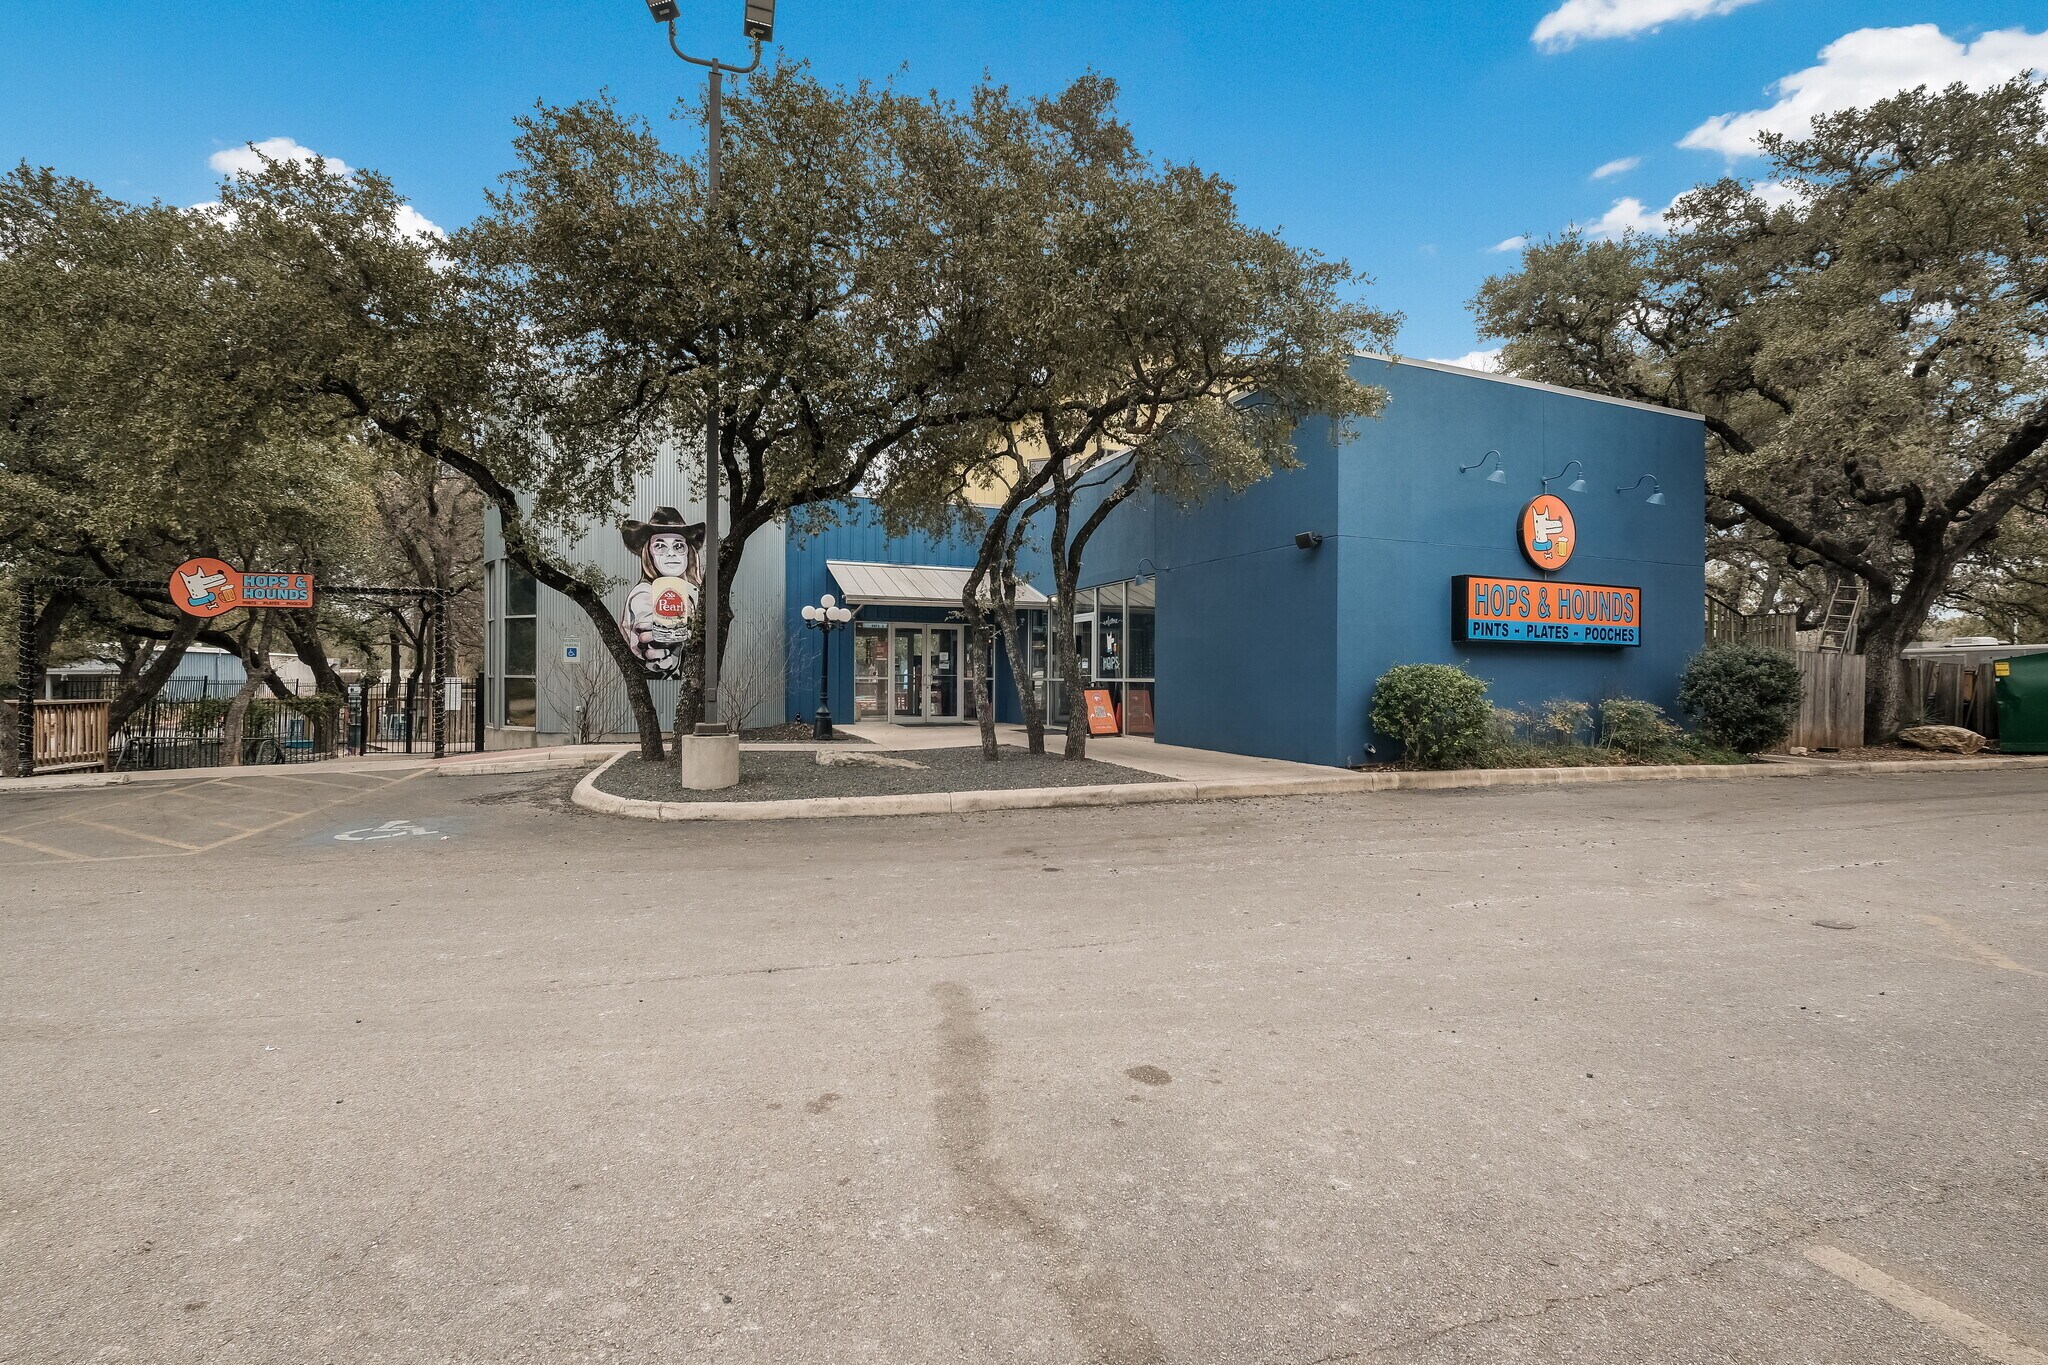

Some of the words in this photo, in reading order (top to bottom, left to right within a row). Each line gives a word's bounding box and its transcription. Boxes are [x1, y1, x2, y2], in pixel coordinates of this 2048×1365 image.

[243, 575, 289, 588] HOPS
[295, 576, 308, 588] &
[243, 588, 309, 601] HOUNDS
[1475, 583, 1530, 618] HOPS
[1538, 587, 1550, 619] &
[1558, 588, 1634, 623] HOUNDS
[1473, 621, 1509, 637] PINTS
[1526, 624, 1569, 640] PLATES
[1584, 626, 1635, 642] POOCHES
